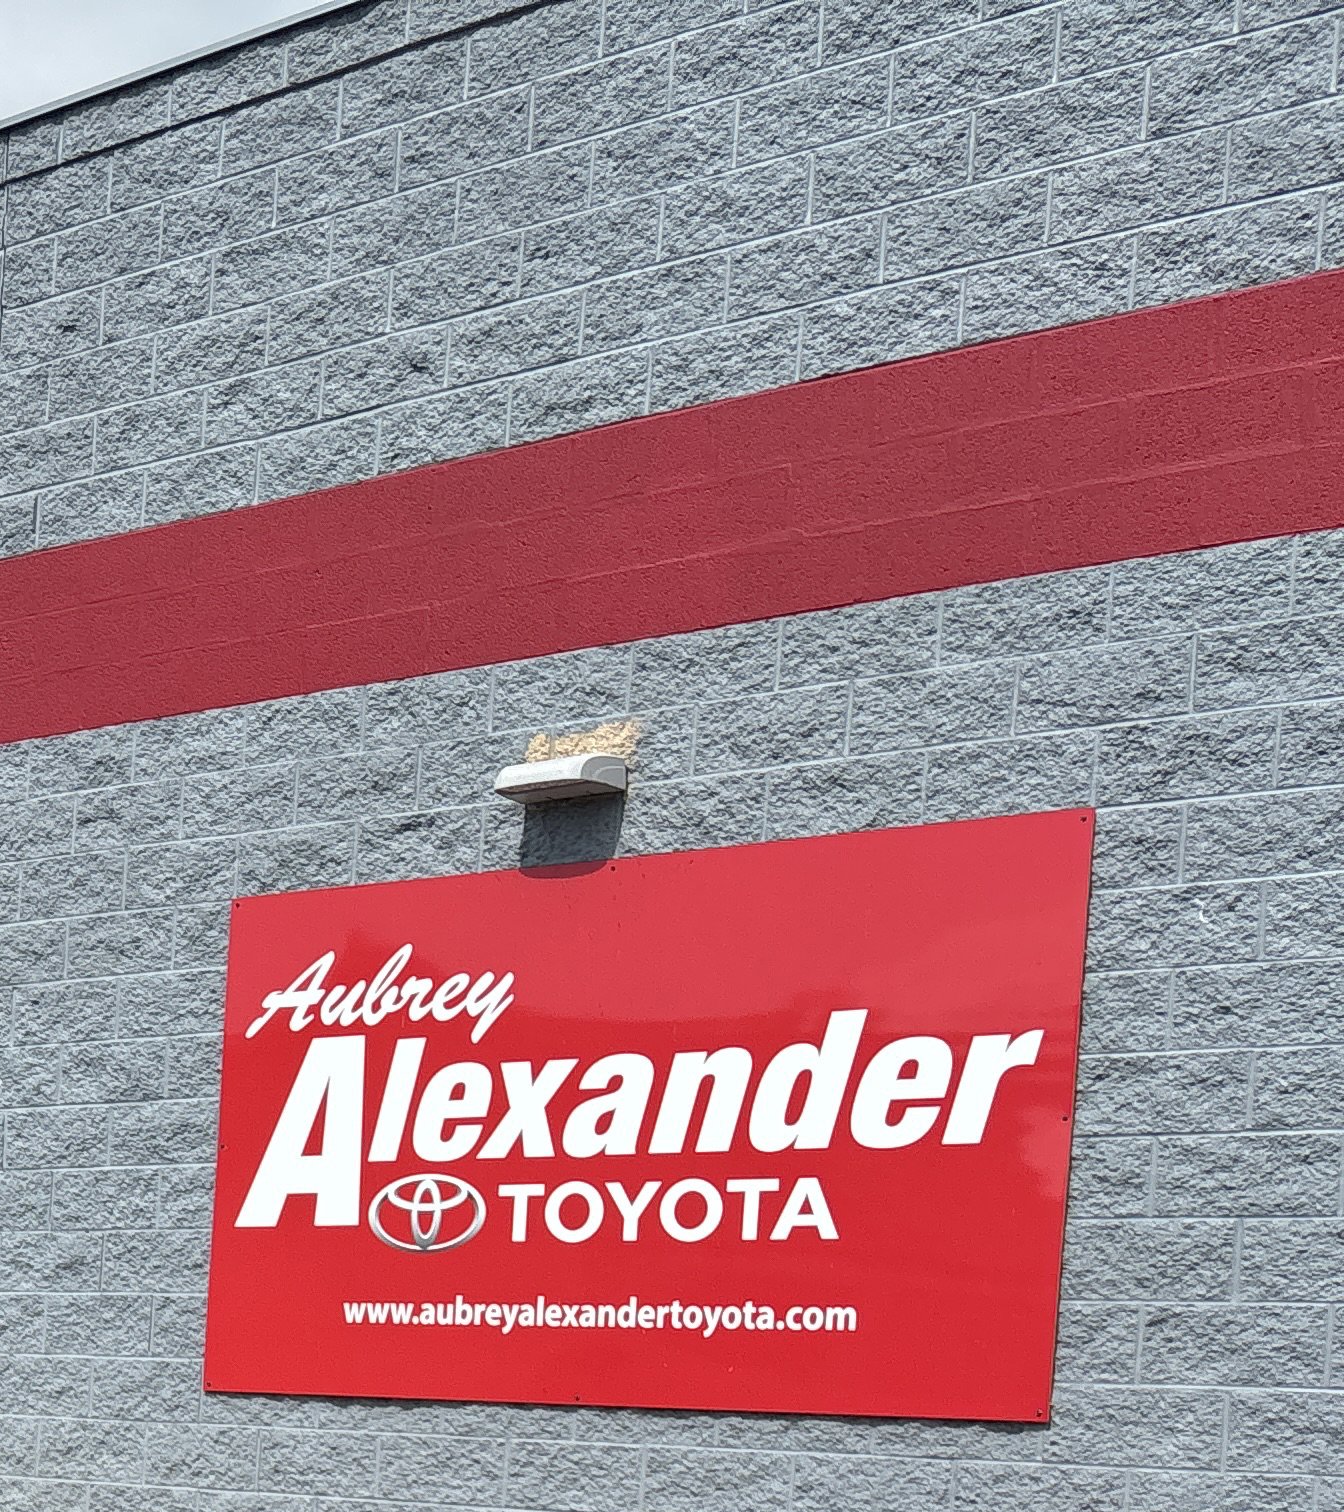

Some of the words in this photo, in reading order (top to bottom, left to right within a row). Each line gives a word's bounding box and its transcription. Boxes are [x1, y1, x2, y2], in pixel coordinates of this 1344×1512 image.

[246, 943, 515, 1043] Aubrey
[234, 1008, 1045, 1228] Alexander
[497, 1177, 840, 1243] TOYOTA
[343, 1294, 858, 1338] www.aubreyalexandertoyota.com
